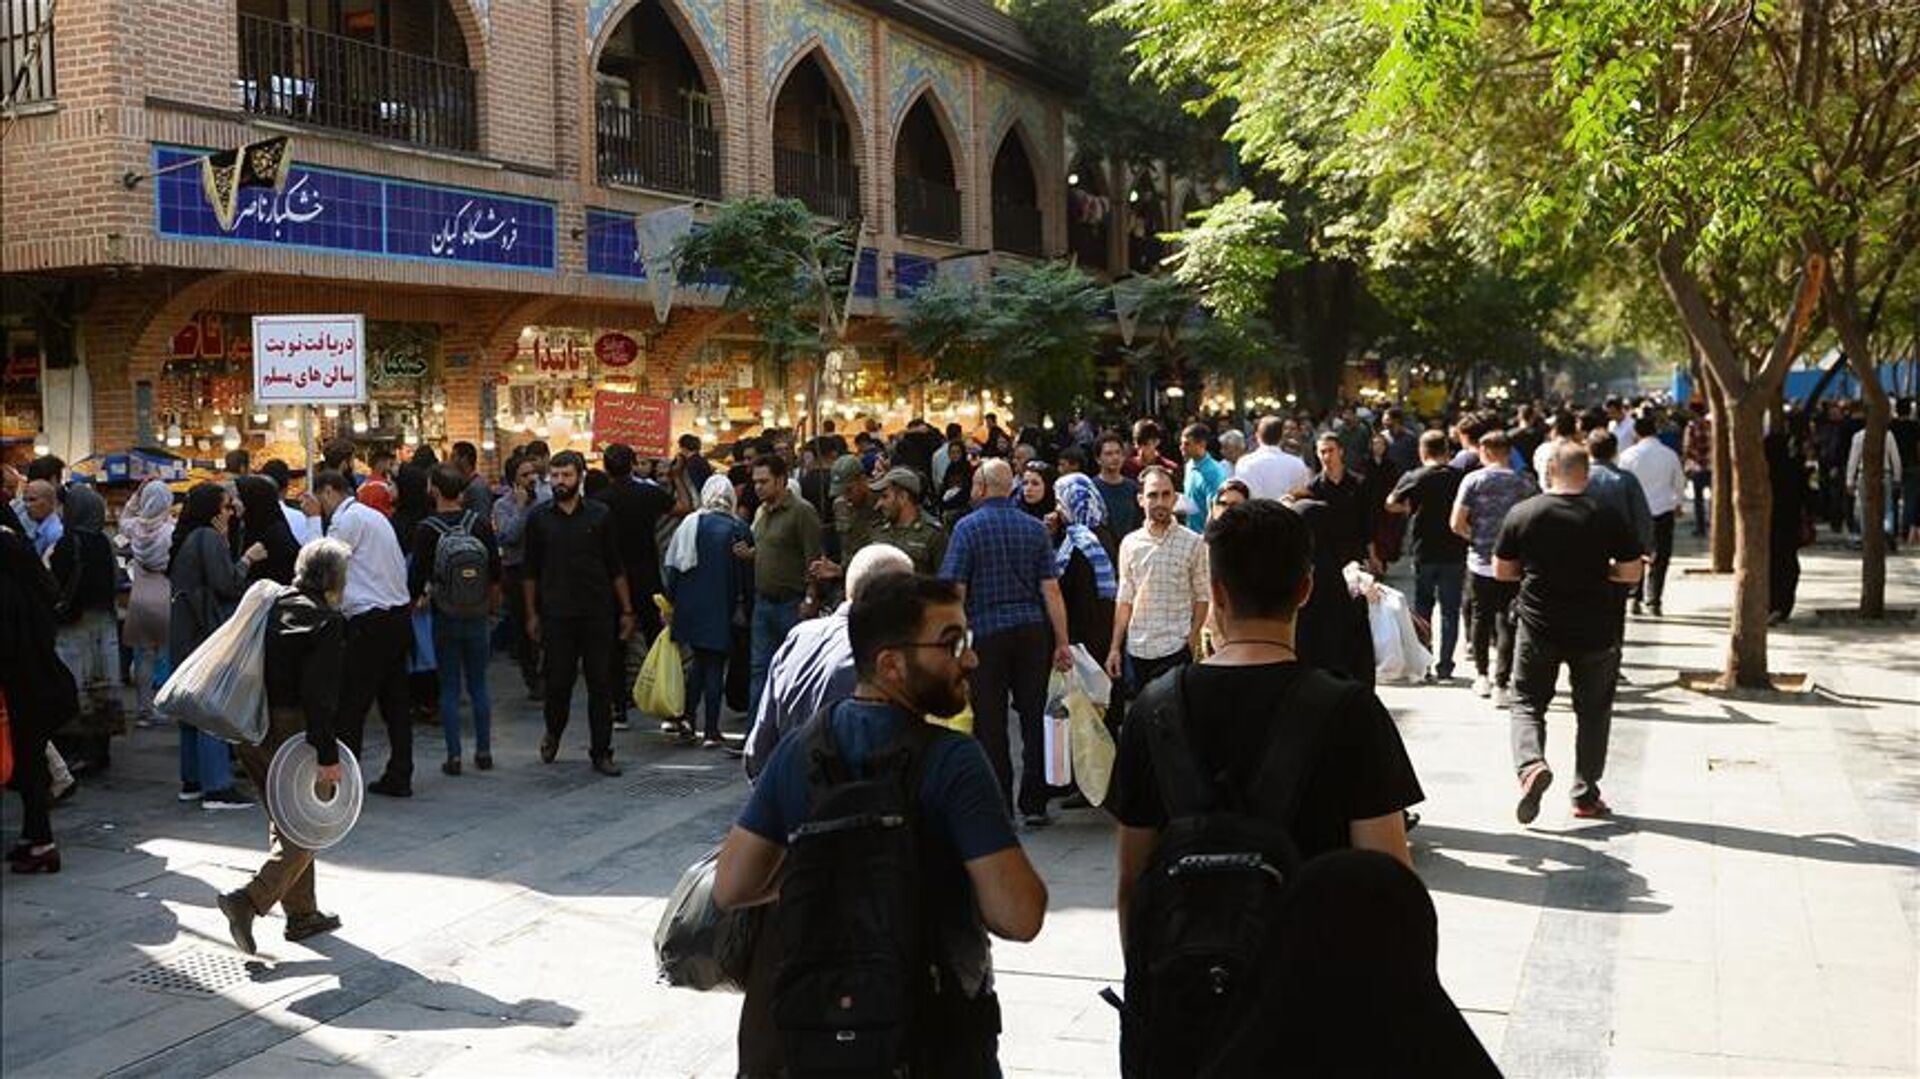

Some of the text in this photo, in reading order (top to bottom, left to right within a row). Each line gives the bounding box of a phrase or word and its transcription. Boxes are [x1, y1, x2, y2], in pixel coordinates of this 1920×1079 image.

[231, 173, 324, 238] خشکبار ناصر
[431, 200, 518, 255] فروشگاه کیان
[265, 332, 303, 358] نوبت
[304, 331, 354, 357] دریافت
[263, 366, 354, 389] سالن های مسلم
